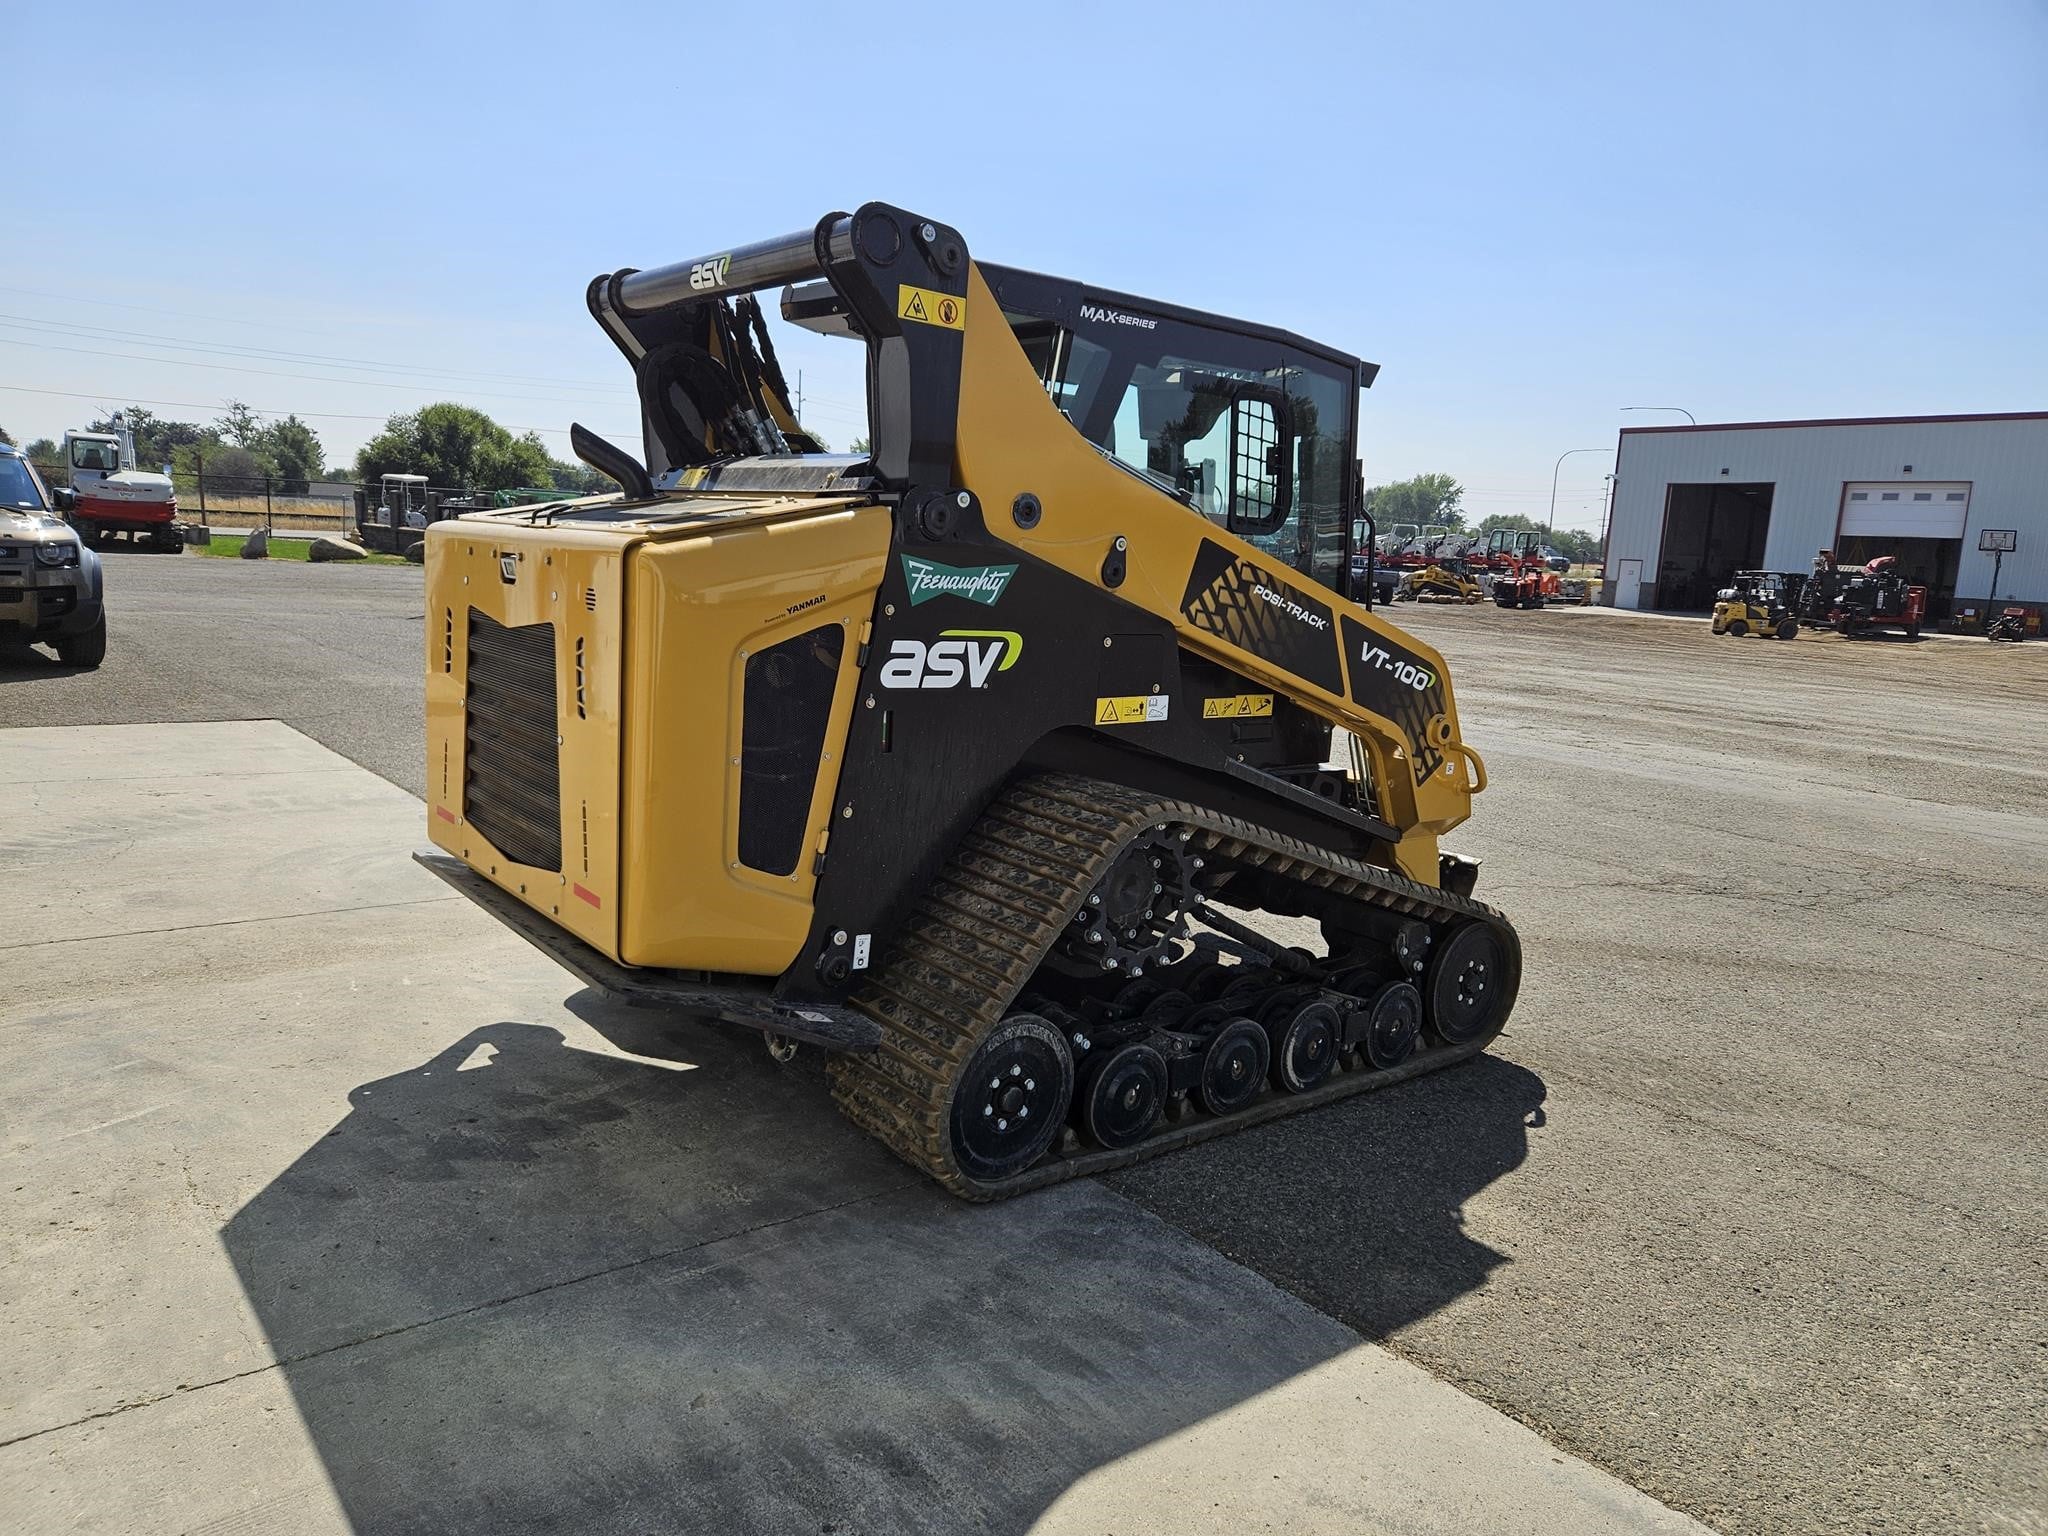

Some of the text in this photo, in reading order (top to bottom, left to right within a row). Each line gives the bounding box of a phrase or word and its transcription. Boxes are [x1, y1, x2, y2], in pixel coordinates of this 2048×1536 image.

[1079, 305, 1157, 330] MAX-SERIES
[908, 560, 1010, 603] Feenaughty
[786, 594, 826, 615] YANMAR
[1253, 584, 1325, 631] POSI-TRACK
[1361, 641, 1428, 691] VT-100
